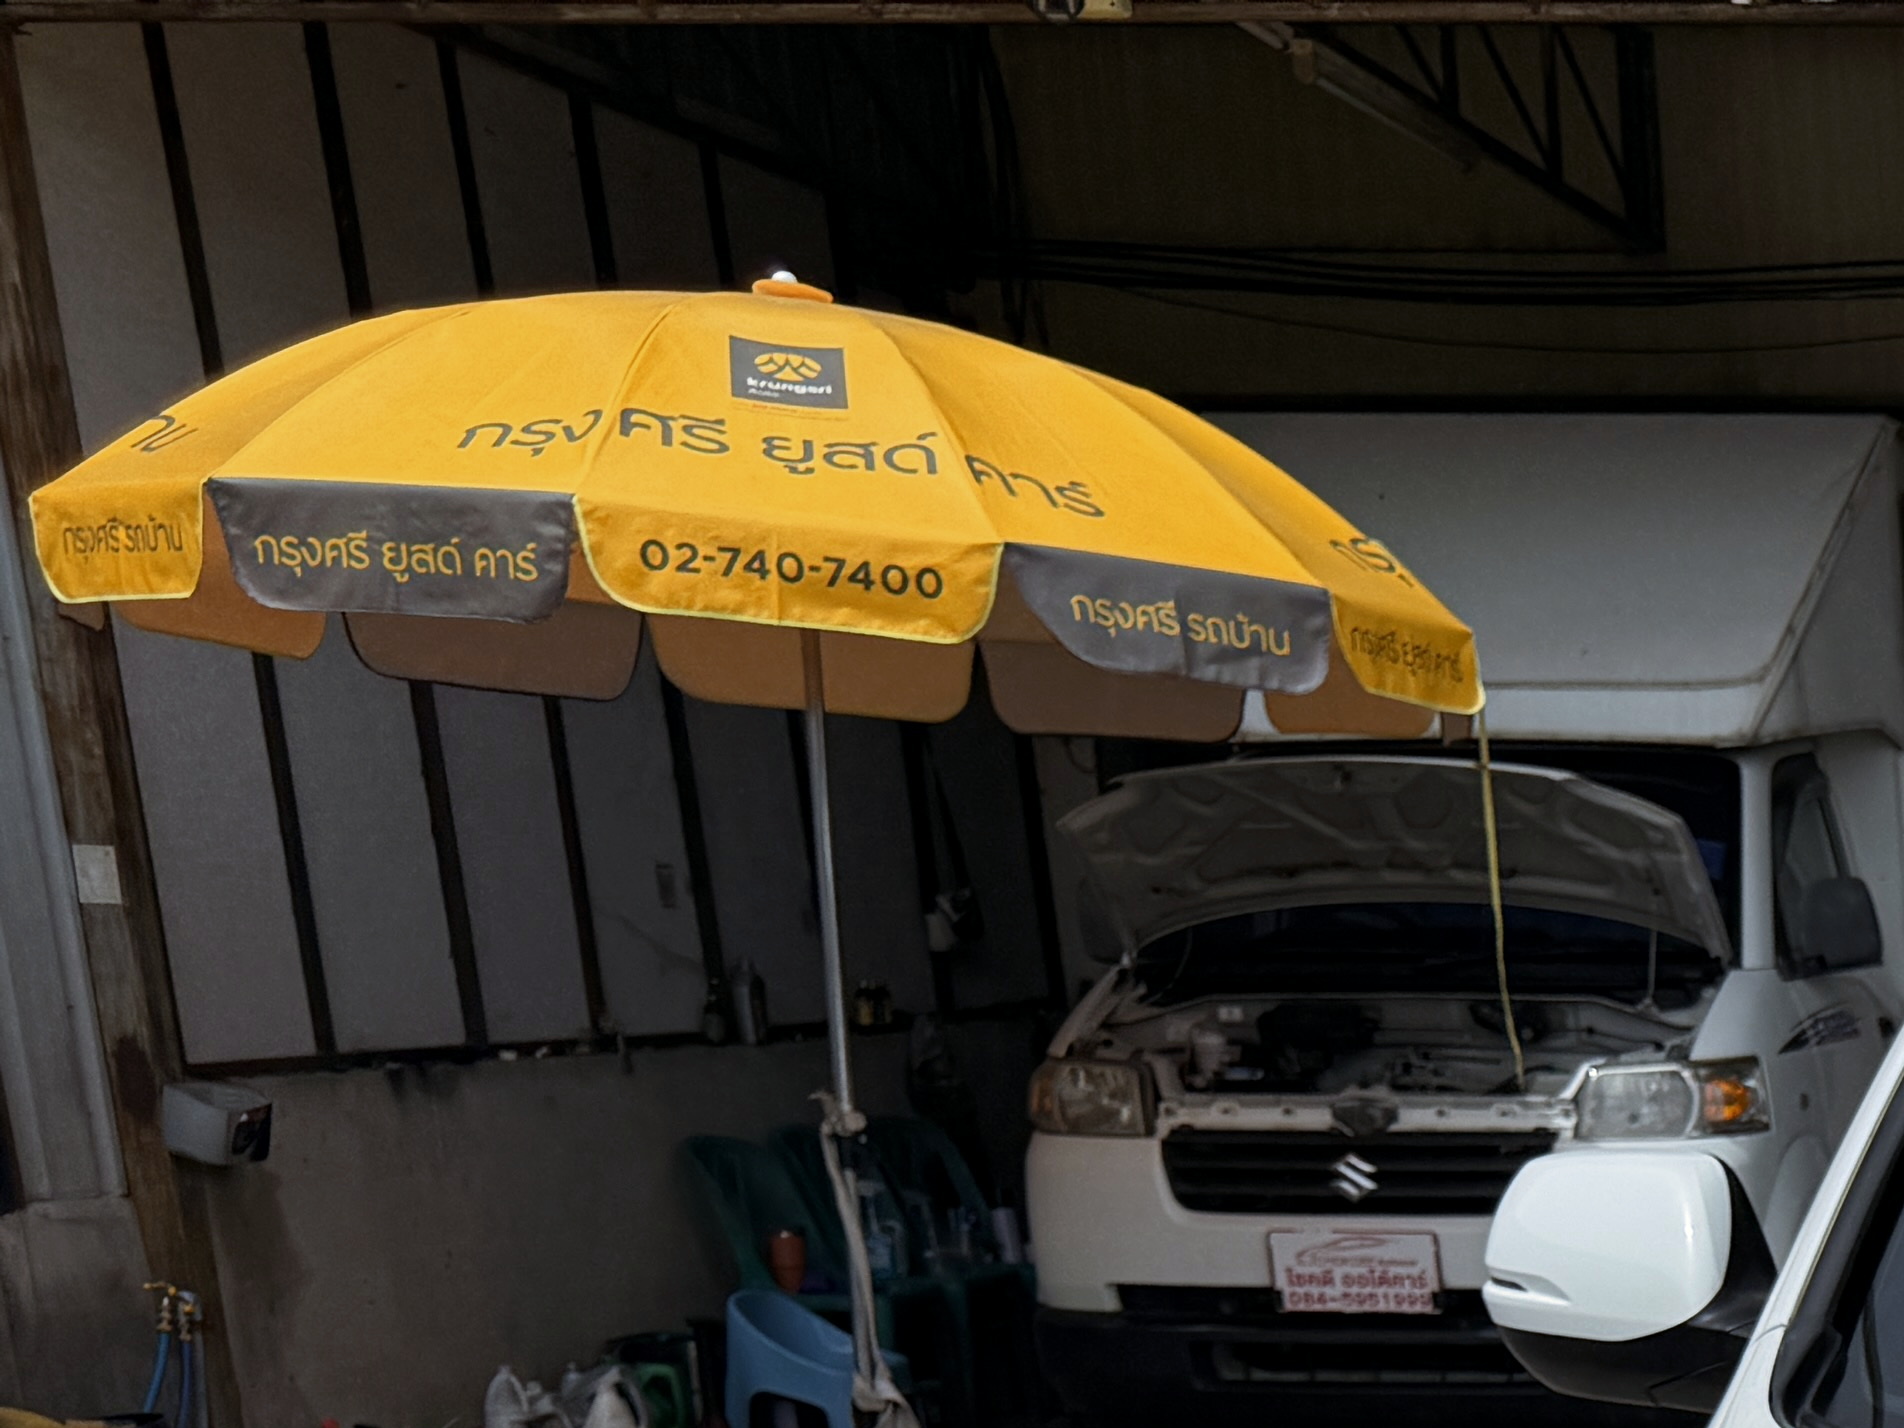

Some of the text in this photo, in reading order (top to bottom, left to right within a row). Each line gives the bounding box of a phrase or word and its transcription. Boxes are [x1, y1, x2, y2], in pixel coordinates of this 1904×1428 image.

[456, 407, 1106, 518] กรุงศรี ยูสด์ คาร์
[254, 529, 539, 583] กรุงศรี ยูสด์ คาร์
[640, 539, 944, 599] 02-740-7400
[1070, 594, 1291, 656] กรุงศรี รถบ้าน
